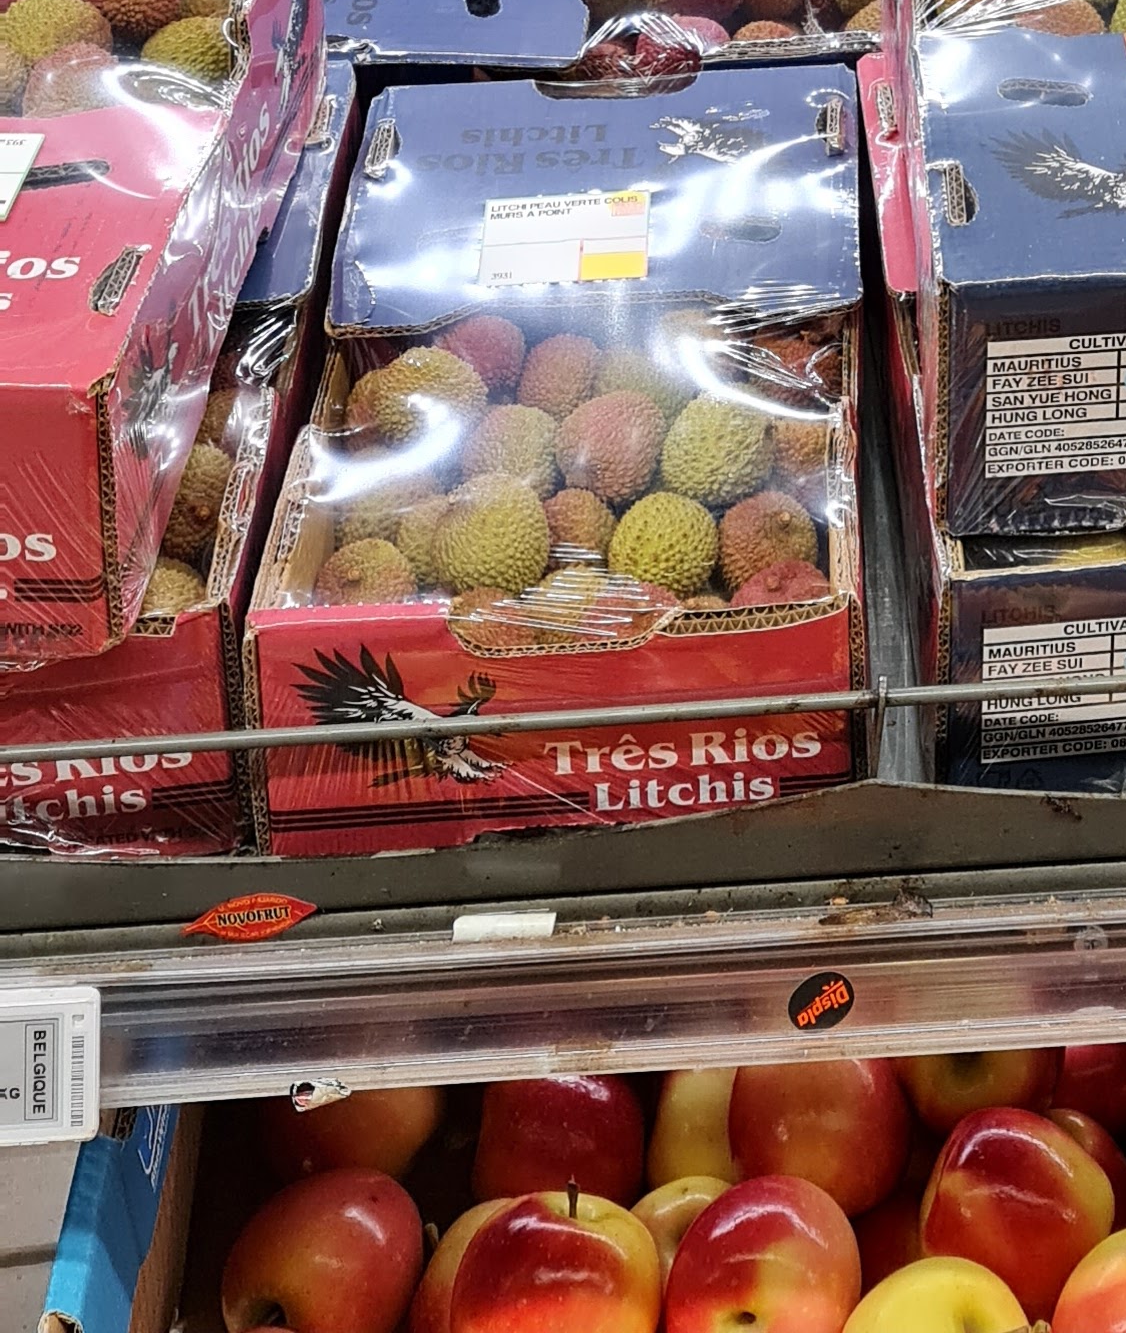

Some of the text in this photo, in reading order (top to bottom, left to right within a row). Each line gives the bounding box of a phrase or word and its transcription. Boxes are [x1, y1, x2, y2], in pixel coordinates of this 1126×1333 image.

[491, 196, 638, 213] LITCHI PEAU VERTE COLIS
[491, 208, 573, 220] MURS POINT
[491, 272, 512, 280] 3931
[992, 356, 1082, 373] MAURITIUS
[992, 376, 1024, 390] FAY
[1027, 374, 1057, 387] ZEE
[1063, 373, 1089, 385] SUI
[992, 389, 1112, 407] SAN YUE HONG
[991, 408, 1087, 425] HUNG LONG
[988, 428, 1065, 442] DATE CODE:
[988, 444, 1051, 457] GGN/GLN
[987, 460, 1064, 474] EXPORTER
[1068, 456, 1114, 468] CODE:
[988, 642, 1076, 659] MAURITIUS
[988, 665, 1018, 677] FAY
[1022, 661, 1051, 674] ZEE
[1057, 659, 1083, 670] SUI
[984, 713, 1059, 728] DATE CODE:
[983, 728, 1046, 743] GGN/GLN
[543, 728, 822, 775] Três Rios
[983, 744, 1059, 760] EXPORTER
[1063, 740, 1107, 754] CODE:
[594, 771, 776, 813] Litchis
[33, 1030, 46, 1114] BELGIQUE
